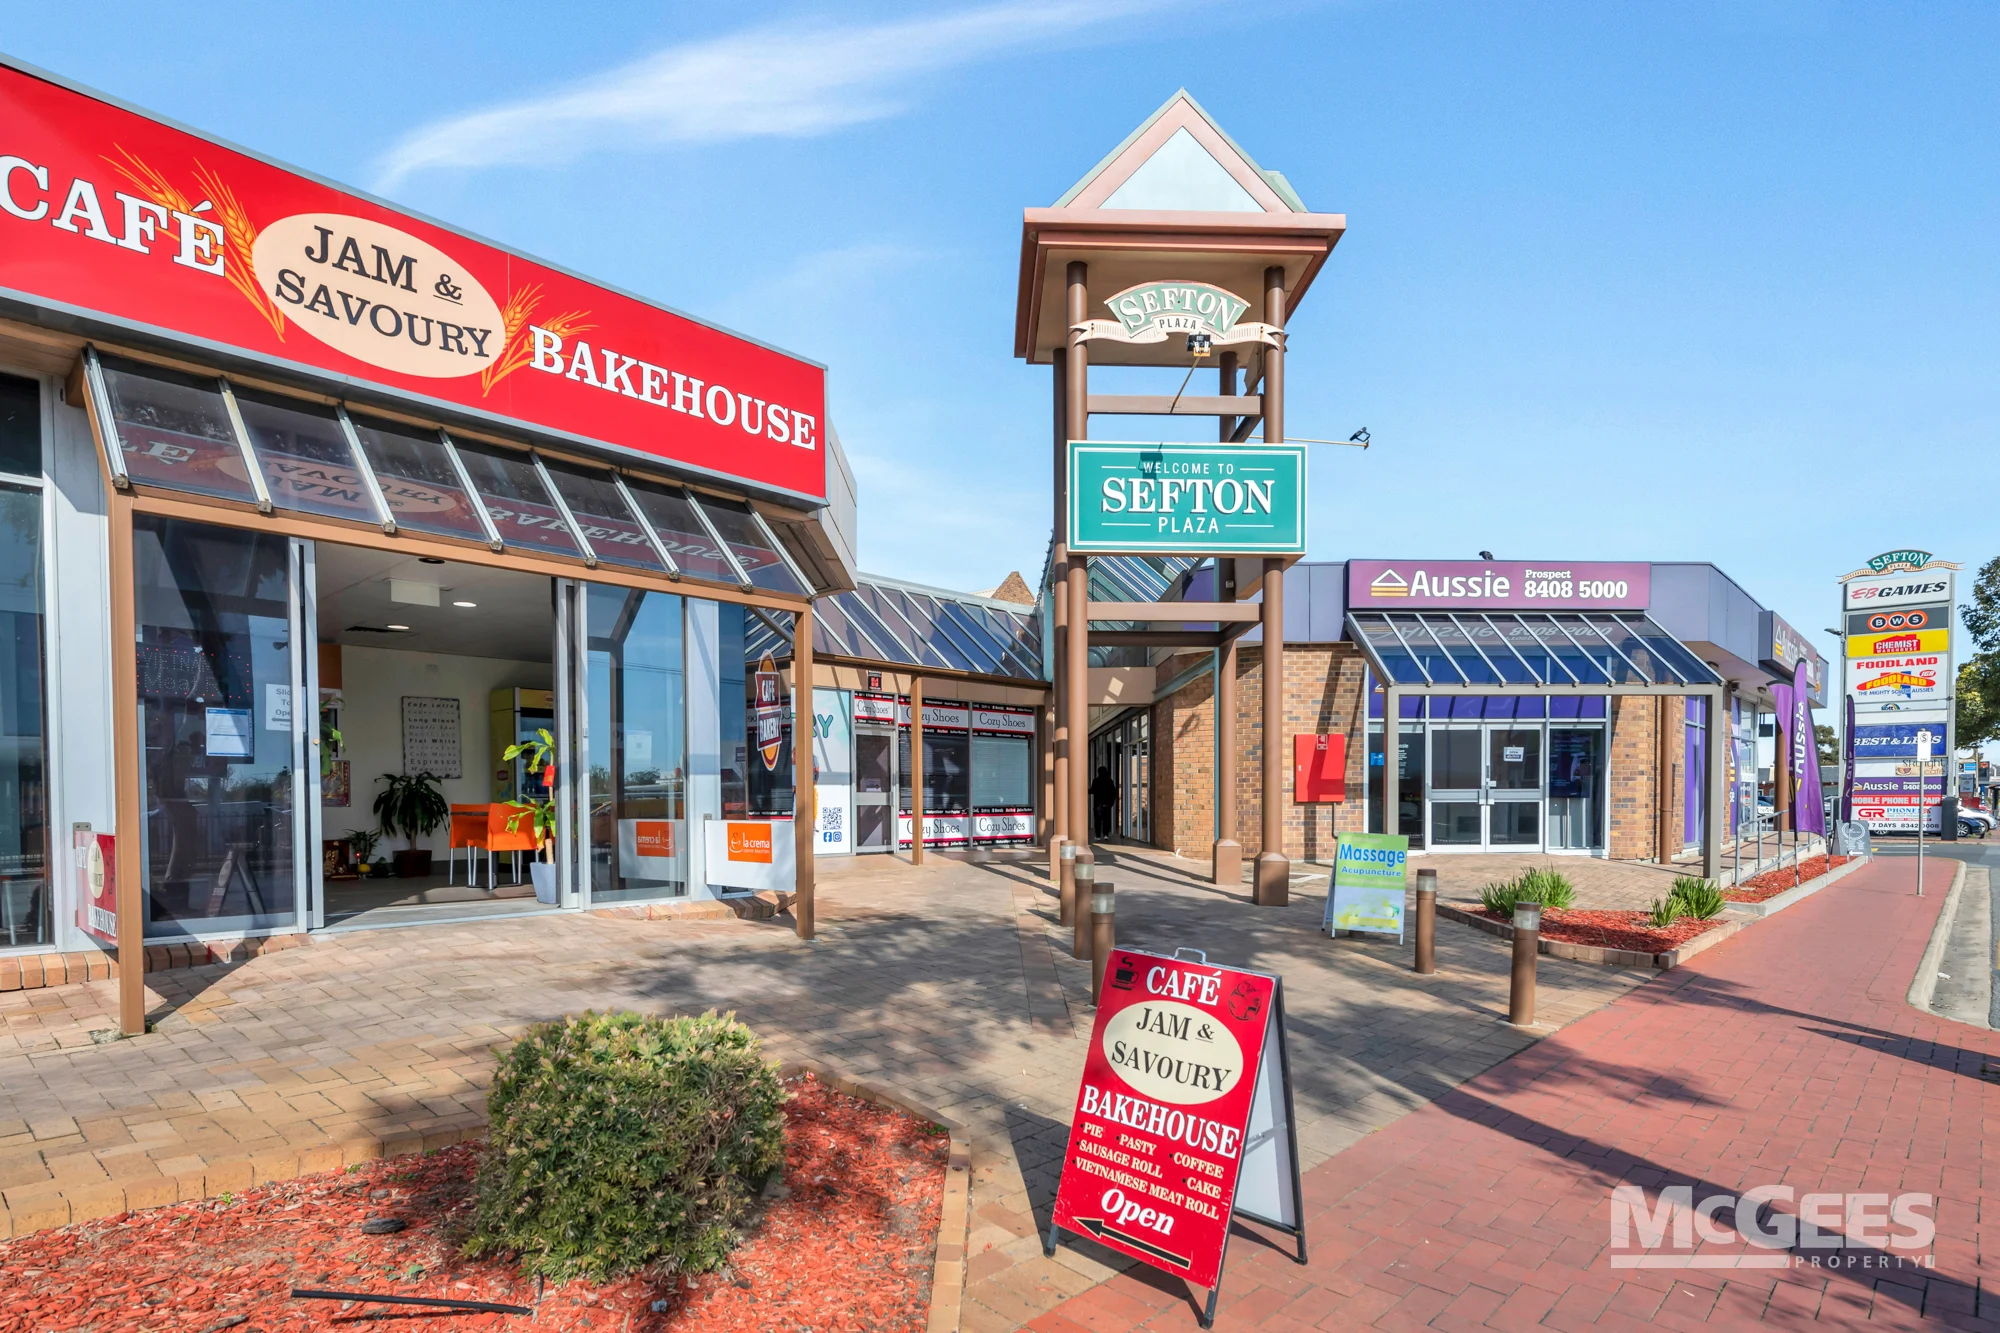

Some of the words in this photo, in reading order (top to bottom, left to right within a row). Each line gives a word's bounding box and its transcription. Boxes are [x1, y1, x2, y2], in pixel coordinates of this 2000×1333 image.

[0, 155, 225, 277] CAFÉ
[304, 225, 418, 293] JAM
[433, 273, 463, 305] &
[275, 268, 492, 358] SAVOURY
[1118, 287, 1240, 332] SEFTON
[1159, 318, 1198, 330] PLAZA
[529, 324, 816, 450] BAKEHOUSE
[1143, 462, 1210, 475] WELCOME
[1218, 463, 1234, 475] TO
[1101, 476, 1275, 515] SEFTON
[1158, 516, 1220, 534] PLAZA
[1872, 552, 1928, 570] SEFTON
[1525, 569, 1571, 580] Prospect
[1410, 570, 1510, 598] Aussie
[1524, 581, 1573, 598] 8408
[1578, 581, 1628, 599] 5000
[1875, 616, 1921, 626] BWS
[1876, 639, 1918, 649] CHEMIST
[1856, 656, 1938, 669] FOODLAND
[761, 676, 776, 702] CAFÉ
[1866, 673, 1927, 690] FOODLAND
[857, 700, 872, 715] Cozy
[906, 708, 931, 723] Czy
[932, 709, 959, 723] Shoes
[980, 712, 1001, 727] Cozy
[1002, 712, 1026, 727] Shoes
[759, 715, 781, 743] BAKERY
[1890, 737, 1901, 745] &
[1863, 782, 1899, 790] Aussie
[1858, 808, 1885, 817] GR
[906, 819, 931, 837] Czy
[933, 819, 960, 833] Shoes
[980, 817, 1000, 833] Cozy
[1002, 816, 1025, 831] Shoes
[743, 833, 749, 848] la
[750, 839, 770, 849] crema
[1339, 843, 1405, 867] Massage
[1341, 866, 1402, 877] Acupuncture
[1146, 965, 1222, 1007] CAFÉ
[1136, 1007, 1192, 1041] JAM
[1195, 1022, 1215, 1043] &
[1111, 1040, 1232, 1092] SAVOURY
[1080, 1084, 1241, 1159] BAKEHOUSE
[1083, 1122, 1104, 1139] PIE
[1119, 1134, 1157, 1156] PASTY
[1173, 1151, 1224, 1179] COFFEE
[1079, 1139, 1130, 1168] SAUSAGE
[1131, 1157, 1163, 1179] ROLL
[1186, 1177, 1222, 1200] CAKE
[1075, 1156, 1148, 1195] VIETNAMESE
[1148, 1184, 1185, 1206] MEAT
[1184, 1197, 1220, 1221] ROLL
[1100, 1187, 1176, 1236] Open
